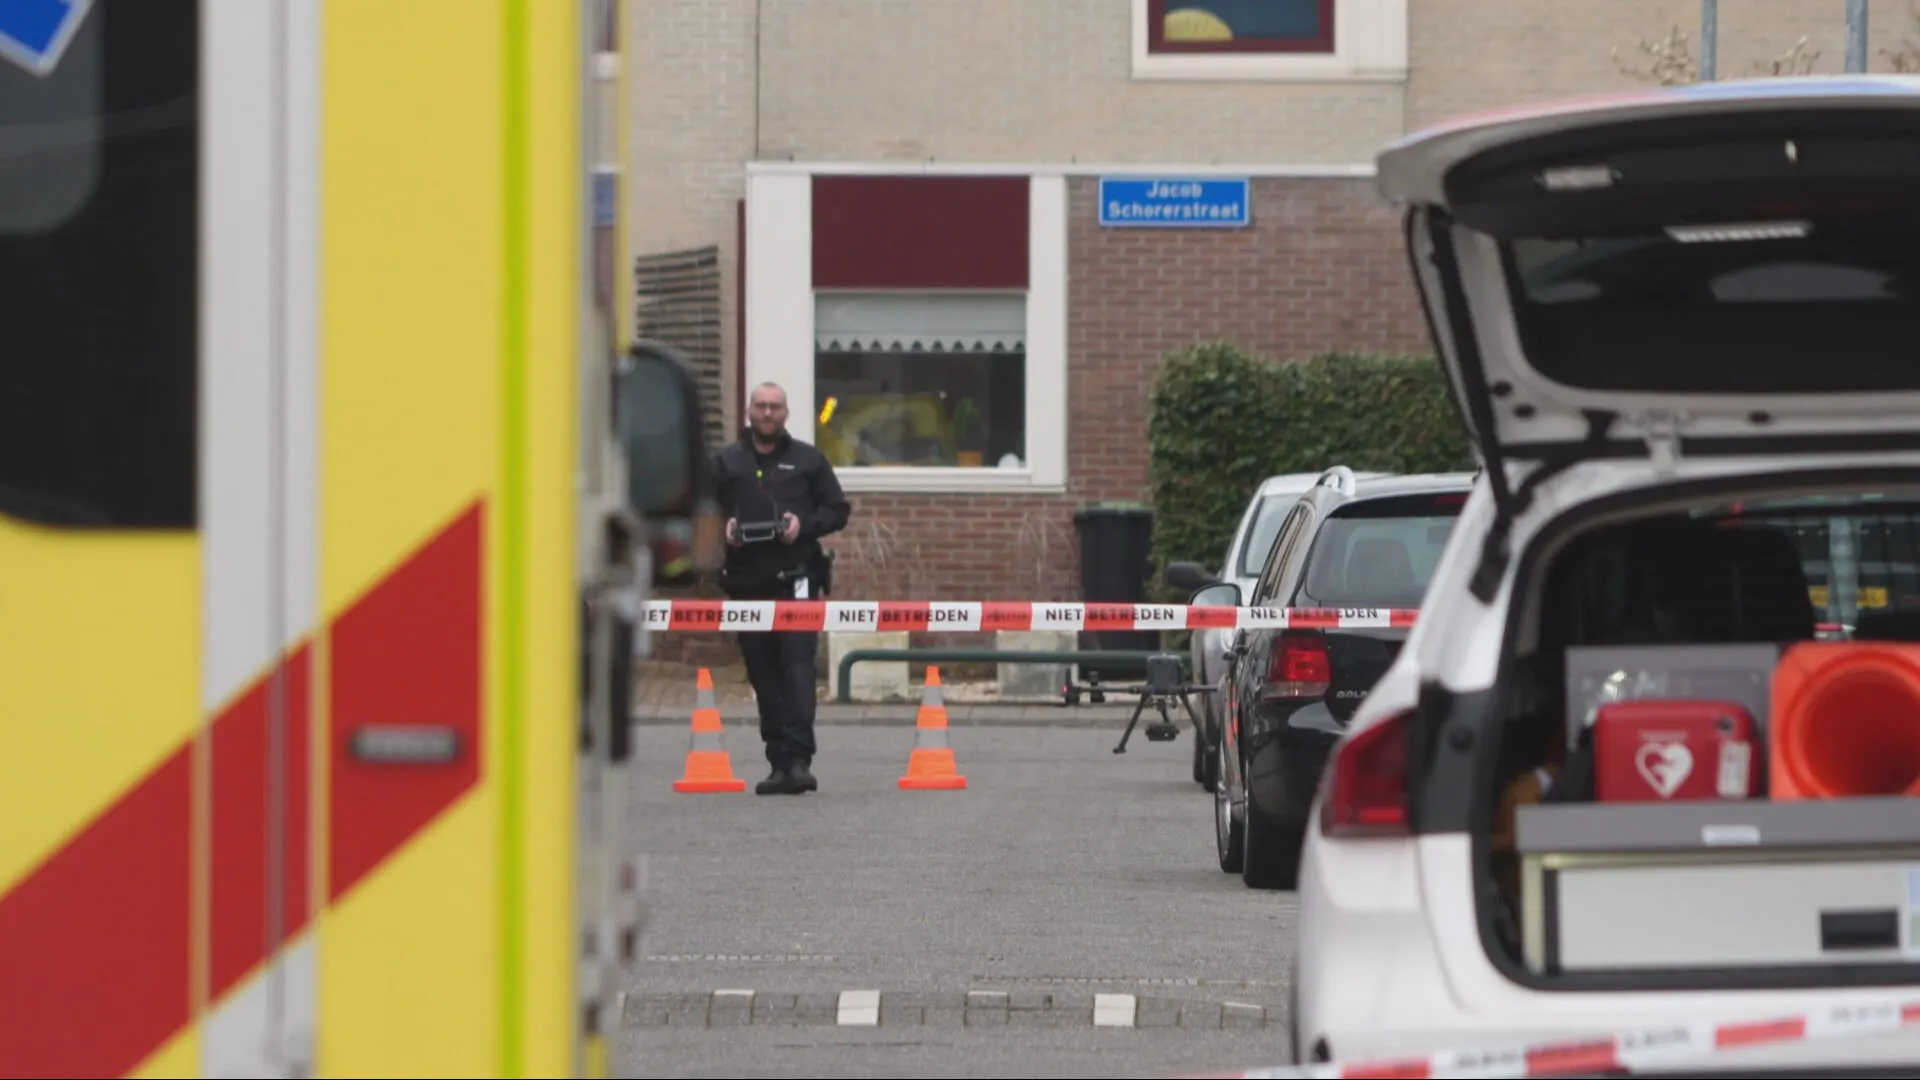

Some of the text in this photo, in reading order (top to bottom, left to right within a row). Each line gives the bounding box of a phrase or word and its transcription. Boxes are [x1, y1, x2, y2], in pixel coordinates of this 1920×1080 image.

[1146, 181, 1203, 198] Jacob
[1108, 201, 1239, 218] Schorerstraat
[641, 609, 668, 622] IET
[674, 609, 761, 622] BETREDEN
[839, 609, 877, 622] NIET
[882, 609, 969, 622] BETREDEN
[1045, 608, 1083, 621] NIET
[1088, 608, 1174, 621] BETREDEN
[1251, 607, 1286, 619] NIET
